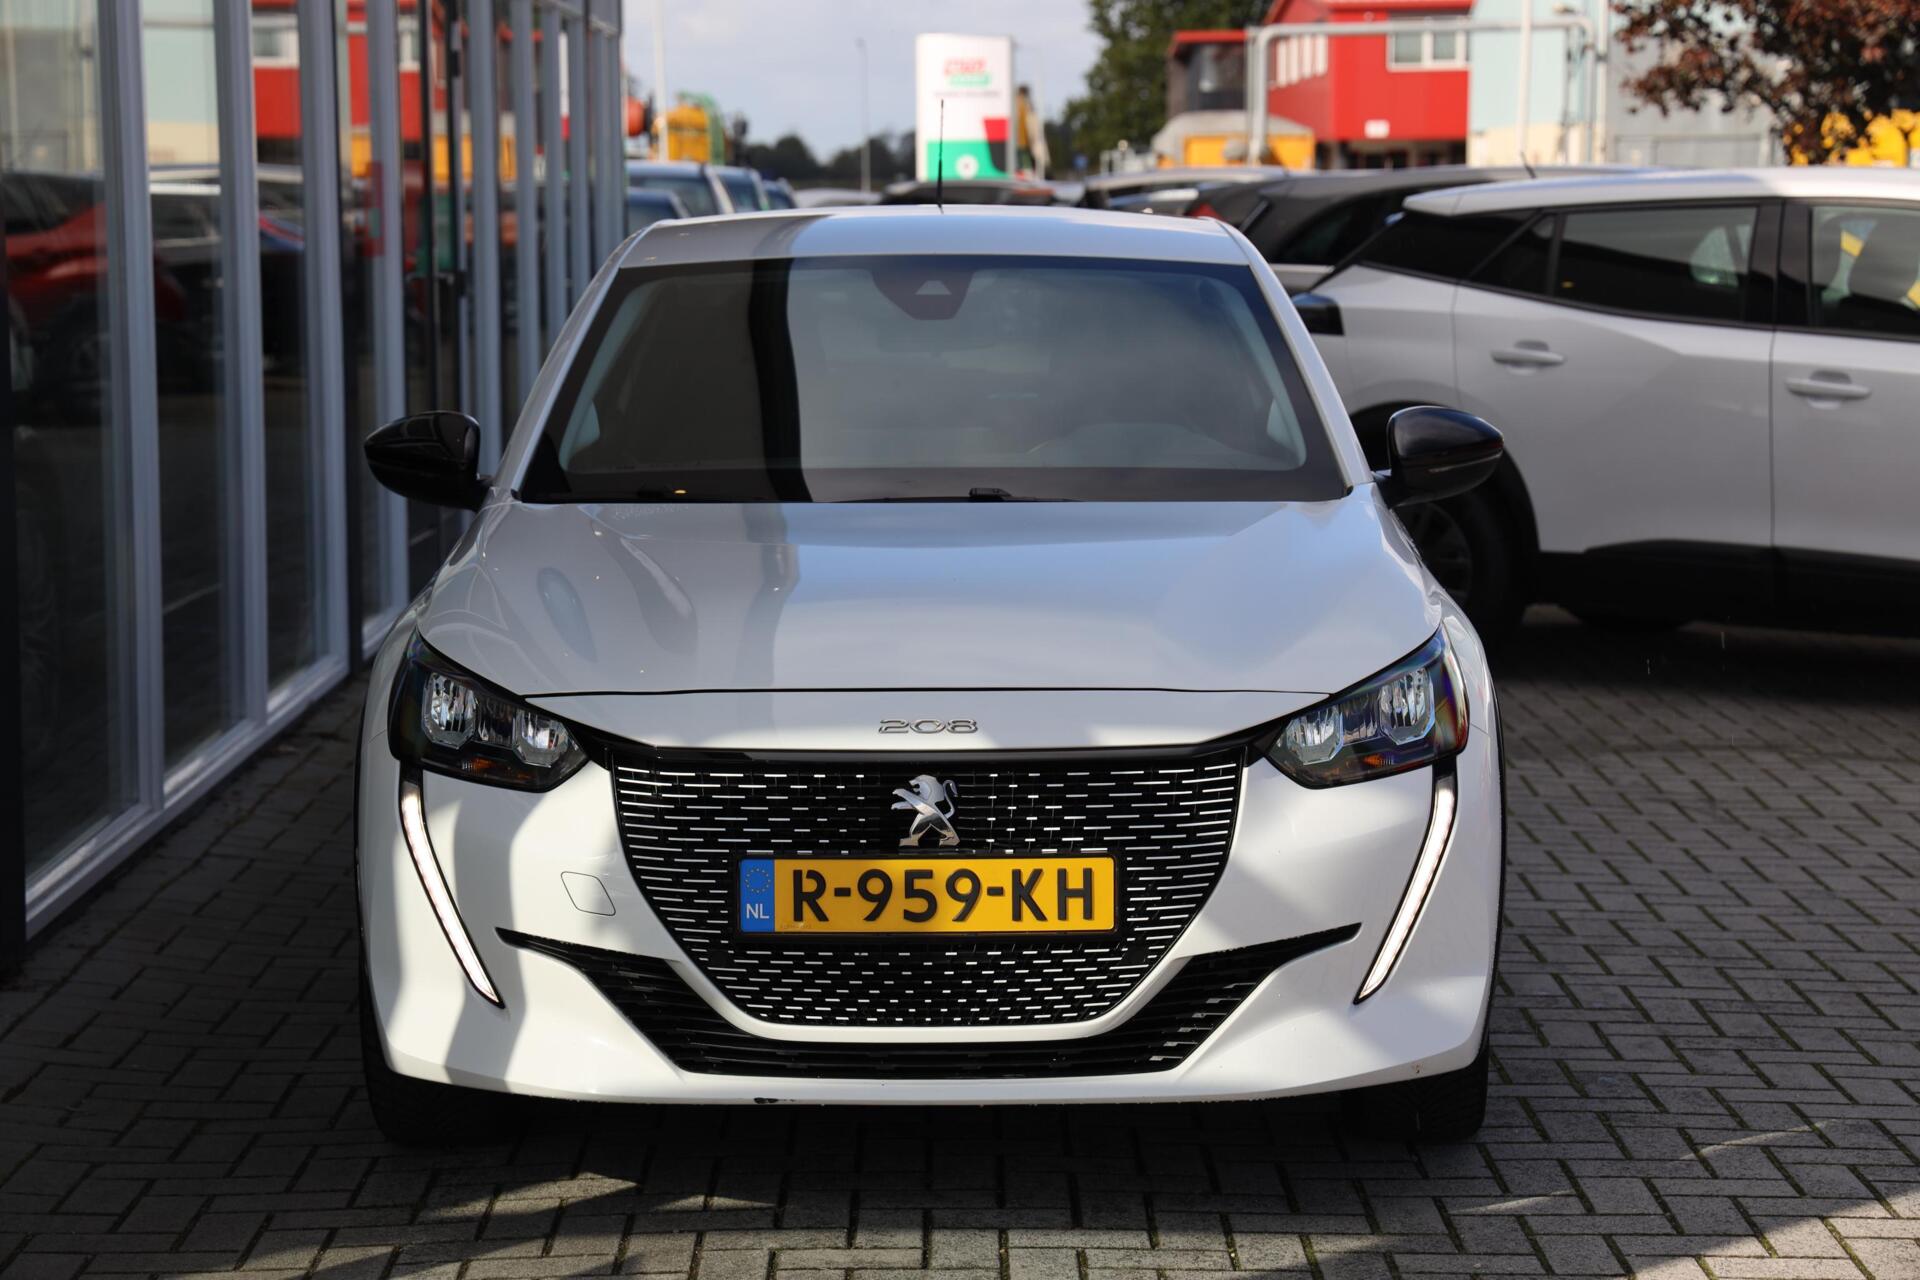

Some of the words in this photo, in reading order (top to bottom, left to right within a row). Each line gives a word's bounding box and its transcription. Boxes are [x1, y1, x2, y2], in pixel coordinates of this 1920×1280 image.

[879, 719, 978, 734] 208
[792, 867, 1094, 923] R-959-KH
[745, 903, 770, 919] NL
